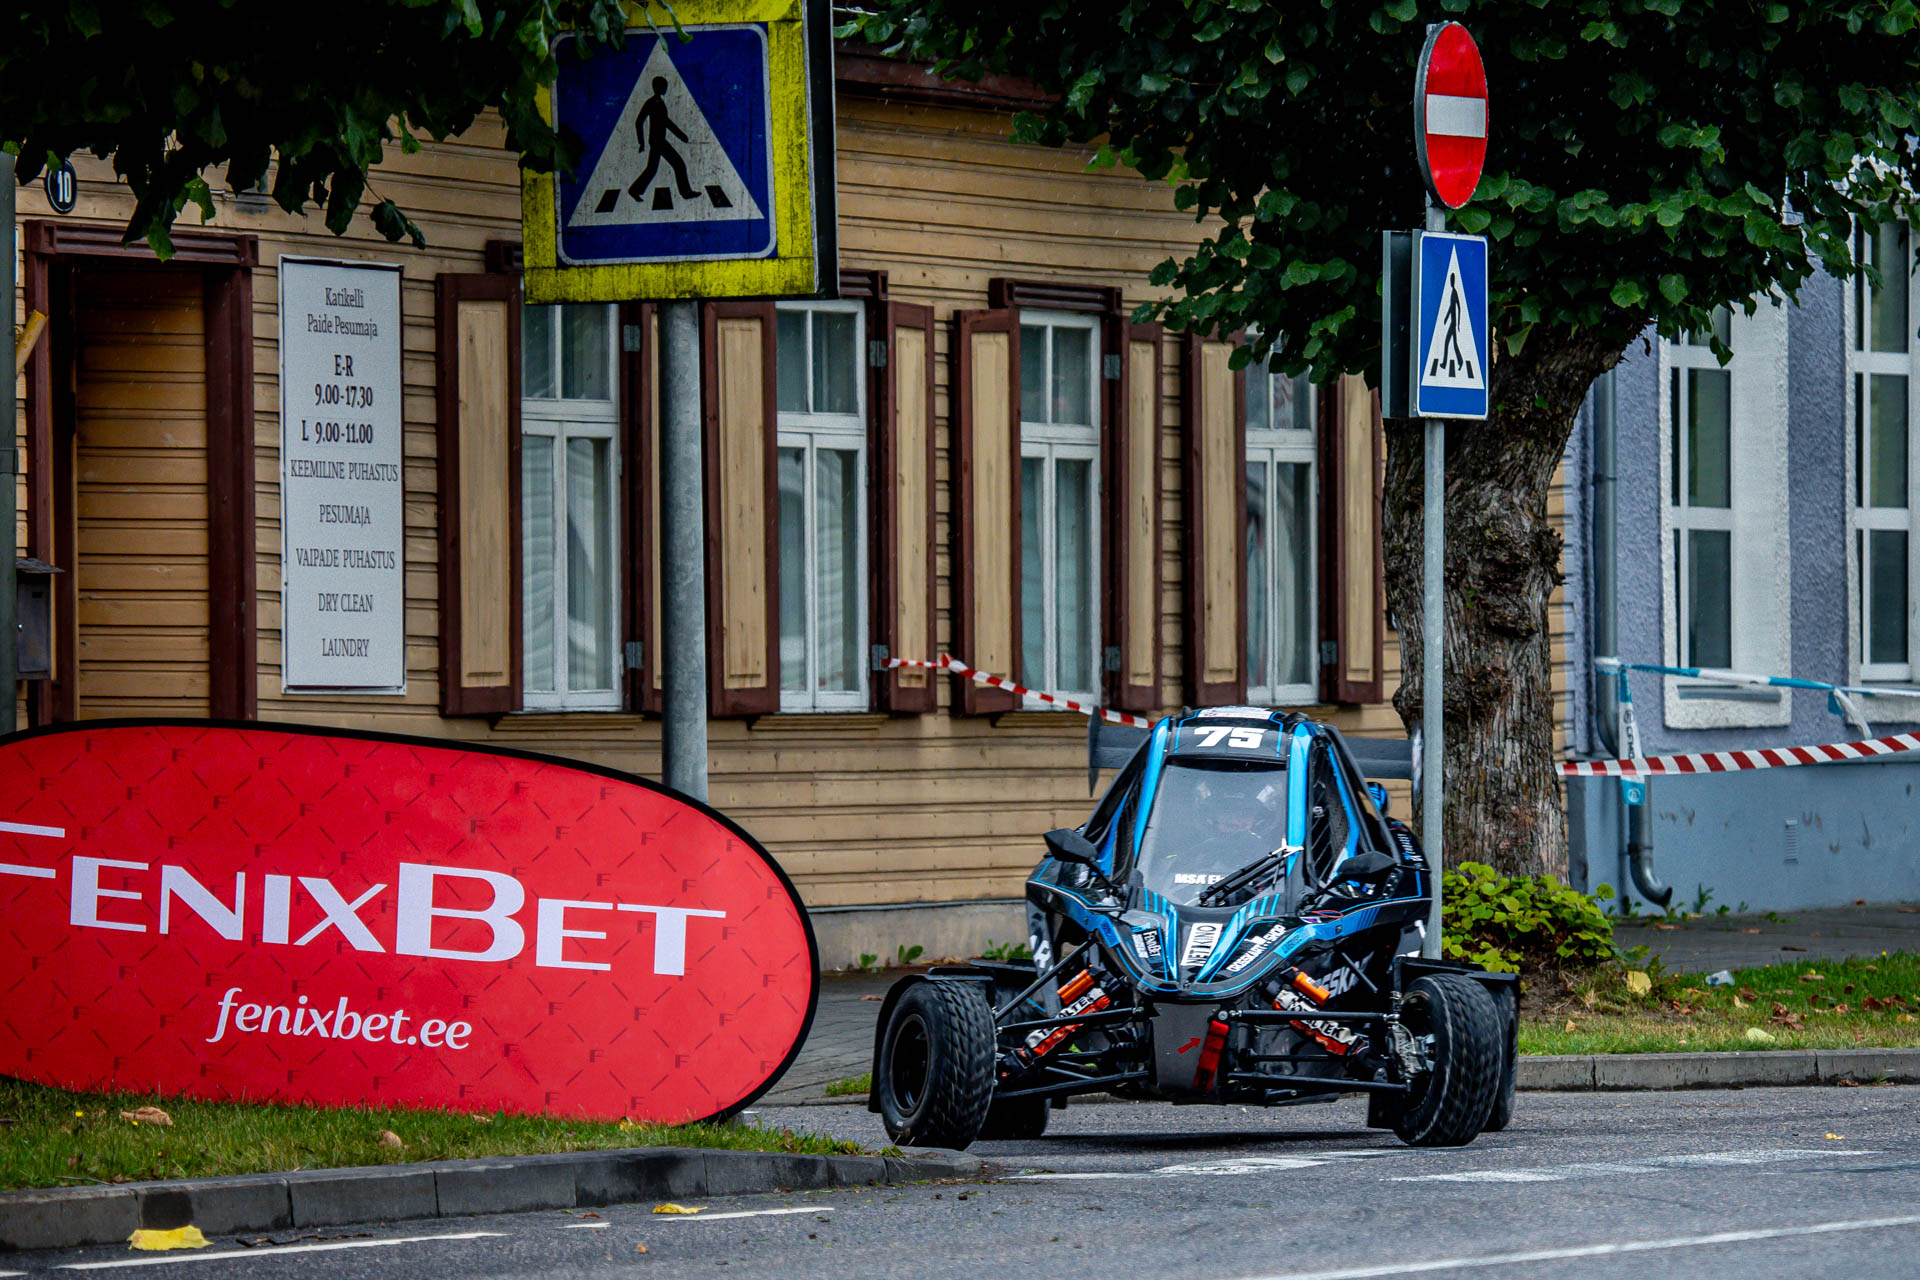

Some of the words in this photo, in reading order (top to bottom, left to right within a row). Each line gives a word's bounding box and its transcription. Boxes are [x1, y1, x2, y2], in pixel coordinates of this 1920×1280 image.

[57, 170, 72, 203] 10
[325, 287, 365, 309] Katikelli
[307, 313, 333, 334] Paide
[334, 315, 378, 340] Pesumaja
[334, 354, 354, 377] E-R
[302, 419, 309, 441] L
[290, 459, 345, 479] KEEMILINE
[348, 462, 398, 482] PUHASTUS
[319, 504, 371, 528] PESUMAJA
[296, 548, 339, 568] VAIPADE
[343, 550, 395, 570] PUHASTUS
[318, 592, 339, 612] DRY
[340, 594, 373, 613] CLEAN
[322, 638, 369, 657] LAUNDRY
[1194, 726, 1268, 749] 75
[206, 987, 472, 1050] fenixbet.ee
